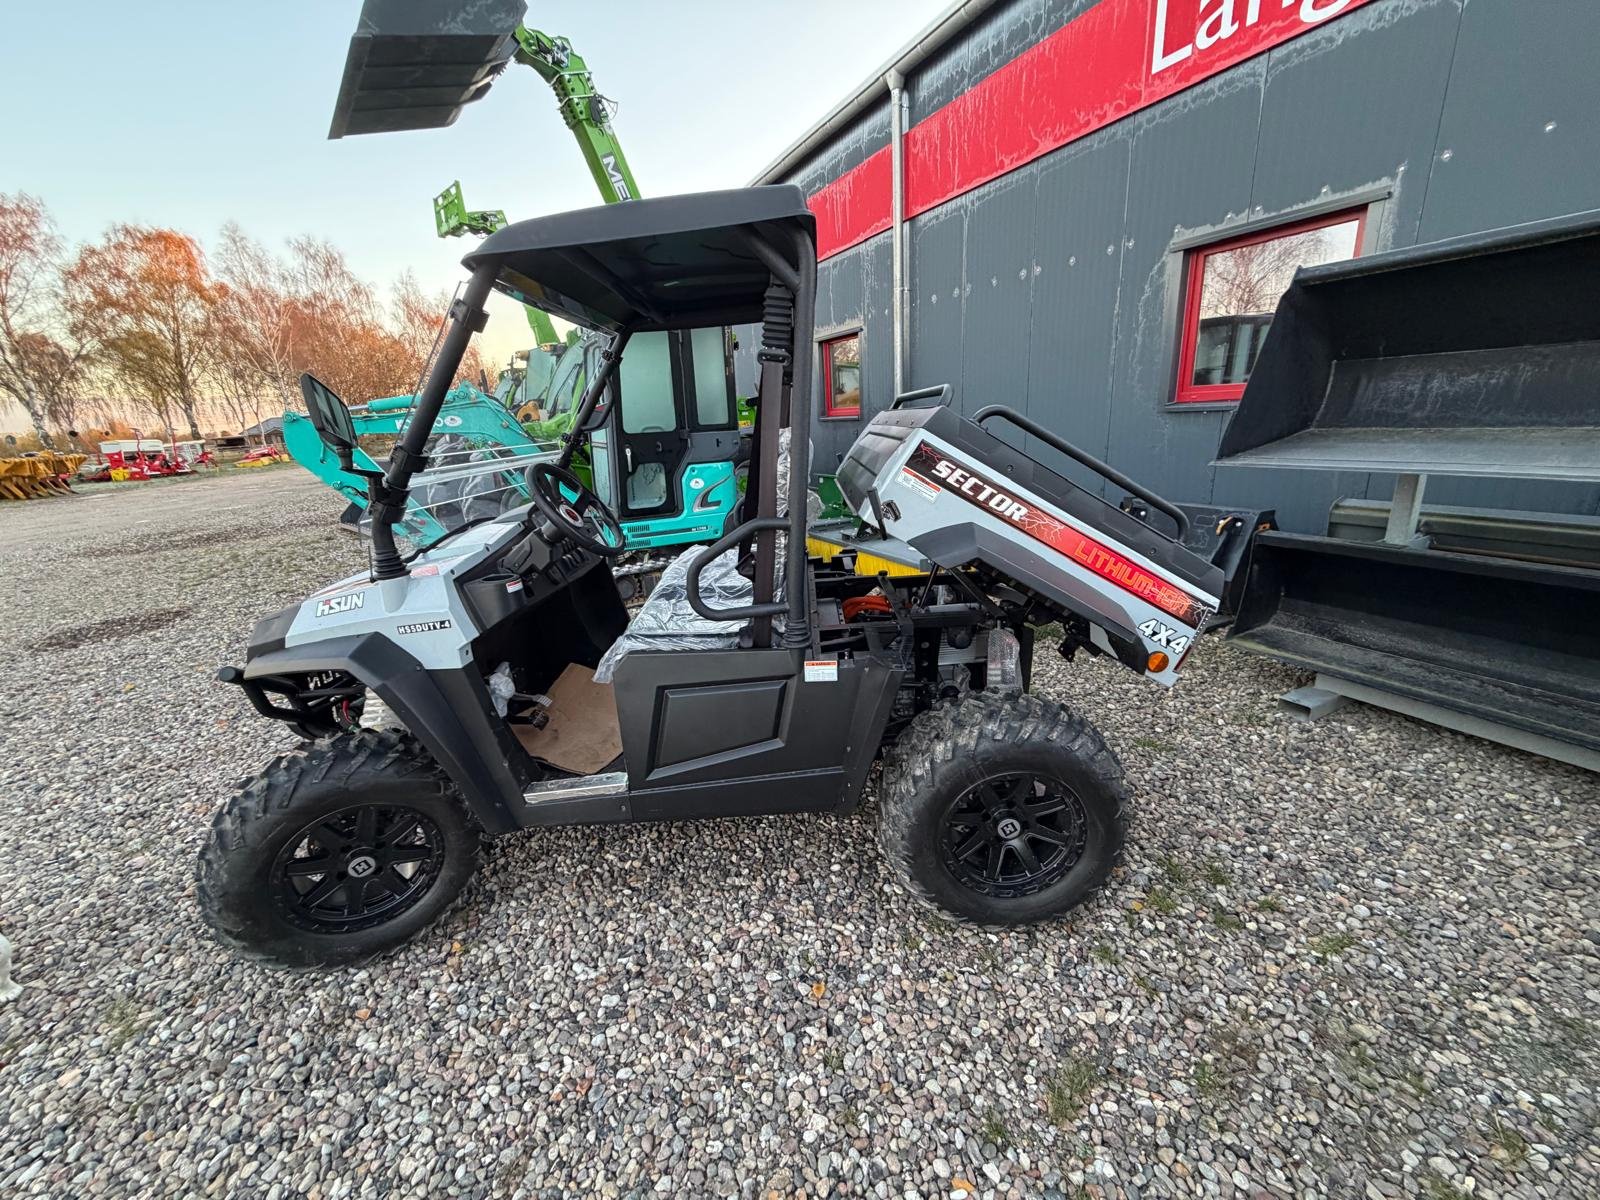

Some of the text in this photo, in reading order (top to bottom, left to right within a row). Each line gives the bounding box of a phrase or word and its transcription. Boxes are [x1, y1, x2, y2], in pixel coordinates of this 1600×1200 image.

[1152, 0, 1352, 75] La
[602, 155, 632, 201] ME
[932, 460, 1028, 521] SECTOR
[1138, 618, 1190, 654] 4X4
